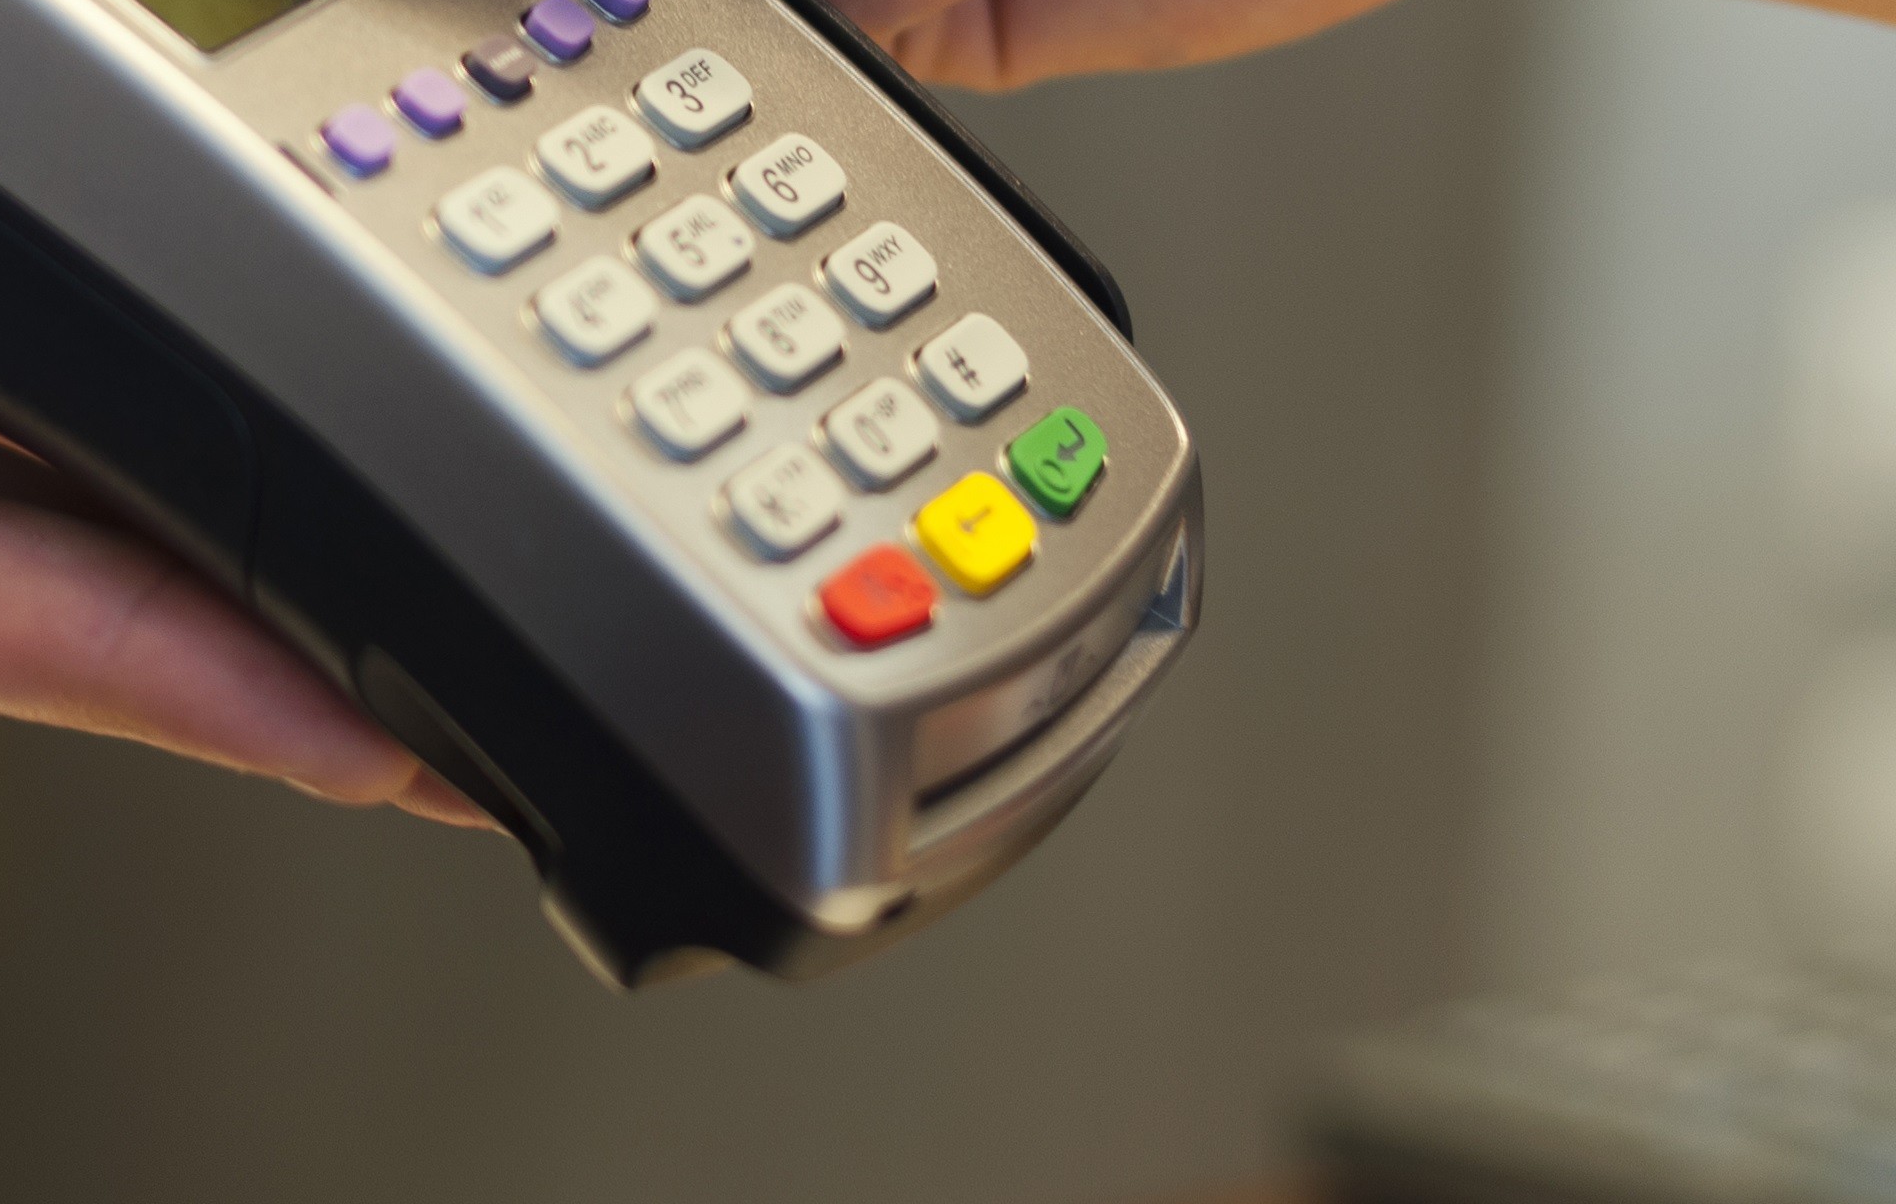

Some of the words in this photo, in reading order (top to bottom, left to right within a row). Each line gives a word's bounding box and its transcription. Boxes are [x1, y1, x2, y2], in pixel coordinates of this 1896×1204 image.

[680, 59, 713, 89] DEF
[665, 79, 704, 113] 3
[775, 145, 814, 177] MNO
[761, 168, 799, 203] 6
[853, 259, 891, 294] 9
